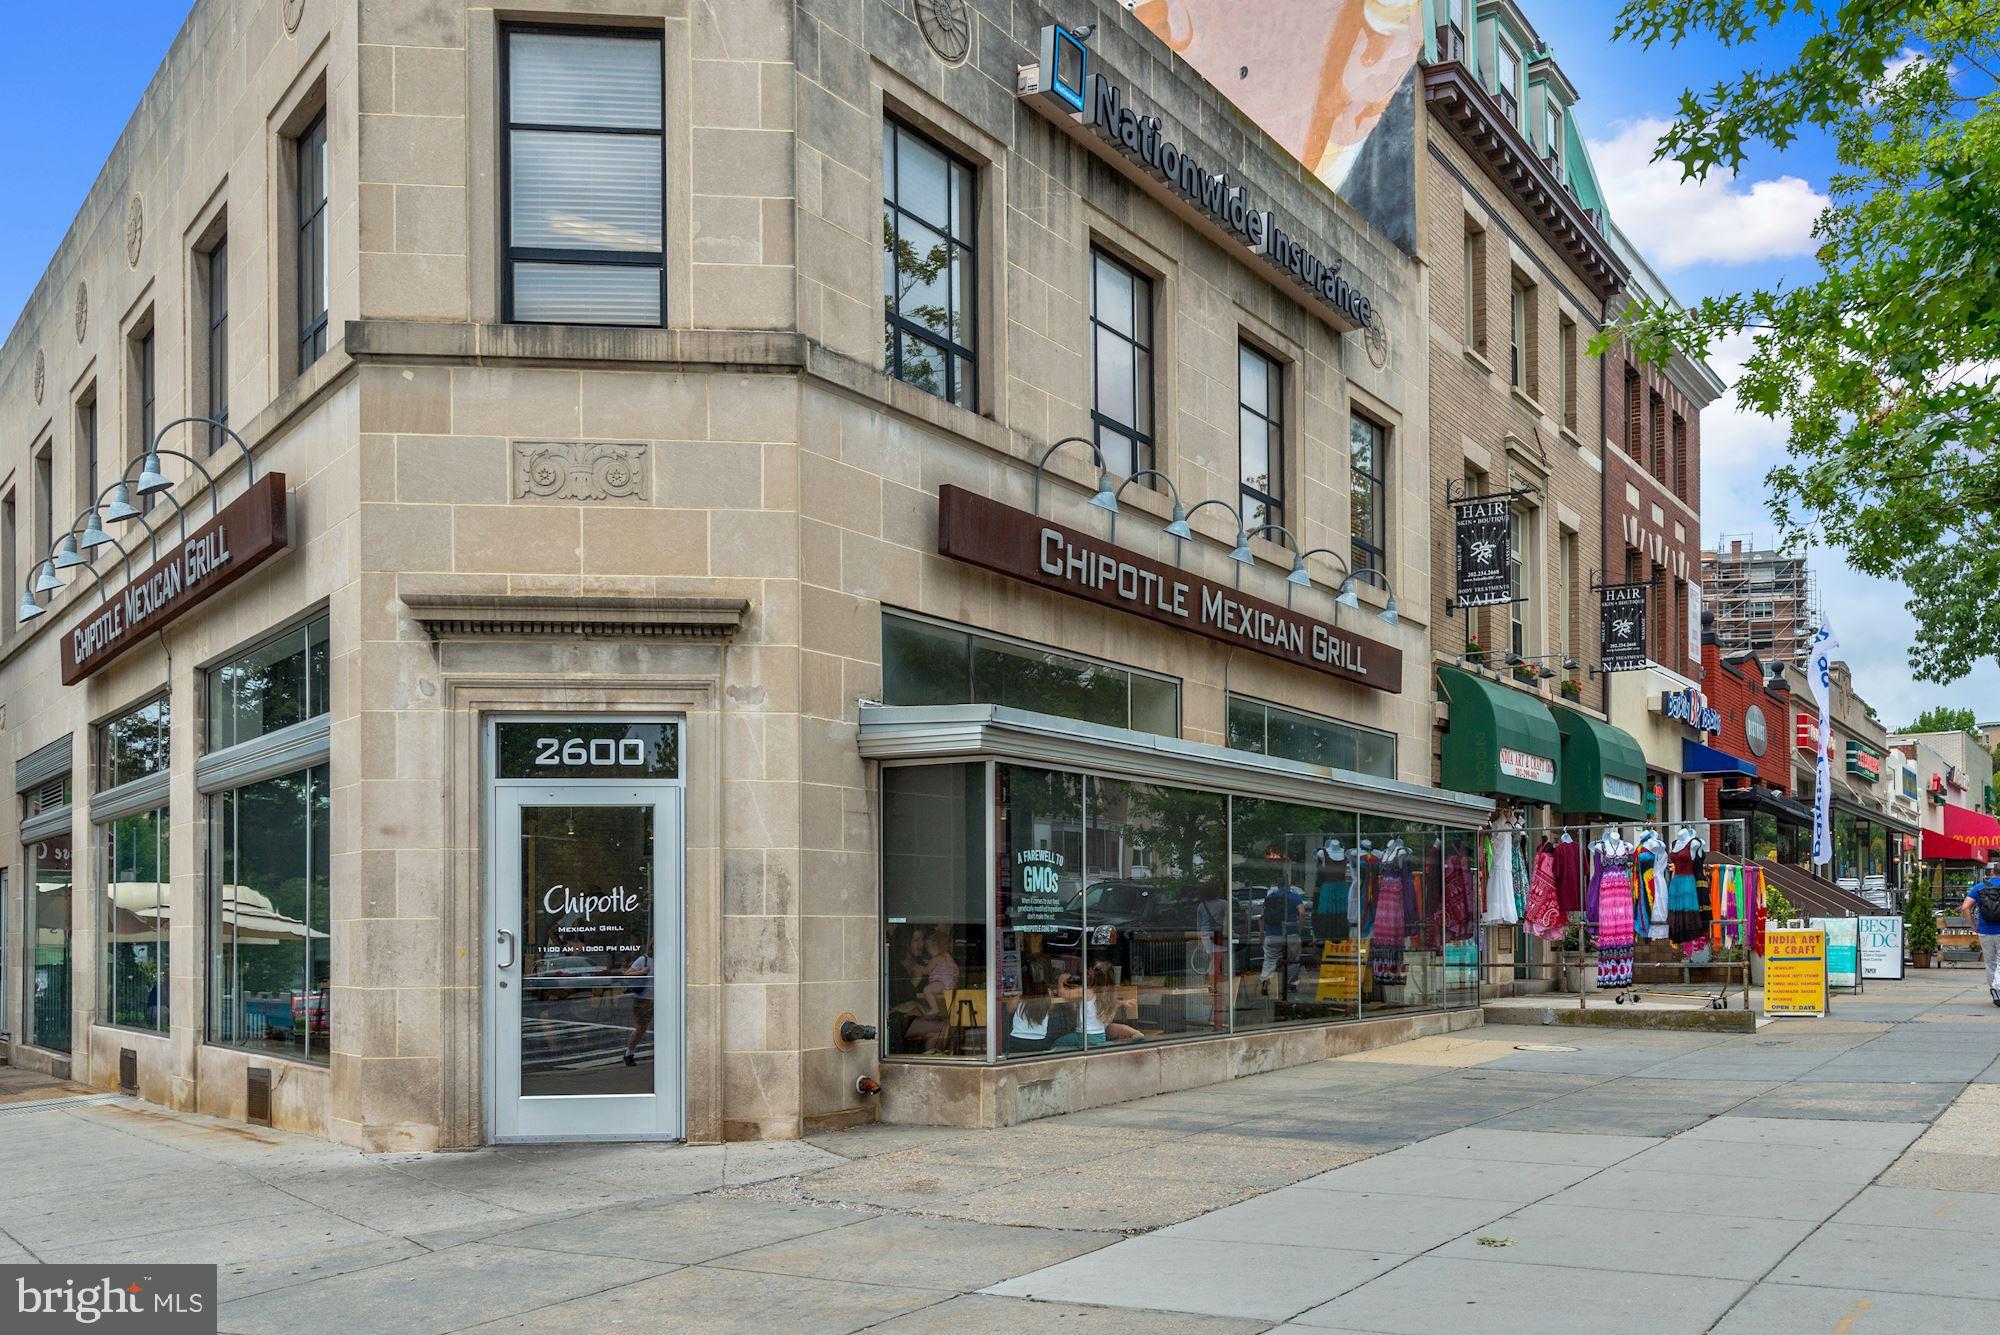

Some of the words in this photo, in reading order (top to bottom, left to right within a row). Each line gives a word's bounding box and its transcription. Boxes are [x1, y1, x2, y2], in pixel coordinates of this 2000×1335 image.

[1098, 74, 1263, 245] Nationwide
[1267, 212, 1372, 327] Insurance
[1463, 502, 1504, 518] HAIR
[74, 601, 123, 665] CHIPOTLE
[125, 557, 182, 630] MEXICAN
[184, 525, 230, 587] GRILL
[1475, 585, 1509, 593] TREATMENTS
[1606, 588, 1640, 601] HAIR
[1040, 527, 1190, 619] CHIPOTLE
[1201, 585, 1304, 655] MEXICAN
[1312, 625, 1367, 676] GRILL
[1459, 591, 1511, 608] NAILS
[1603, 660, 1646, 673] NAILS
[535, 737, 645, 766] 2600
[1500, 750, 1514, 765] NDIA
[1017, 852, 1023, 865] A
[1023, 849, 1055, 864] FAREWELL
[1056, 853, 1064, 867] TO
[544, 885, 639, 922] Chipotle
[1860, 919, 1899, 932] BEST
[1769, 935, 1797, 944] INDIA
[1802, 935, 1820, 944] ART
[1872, 933, 1899, 948] D.C.
[1773, 946, 1780, 954] &
[1785, 945, 1816, 954] CRAFT
